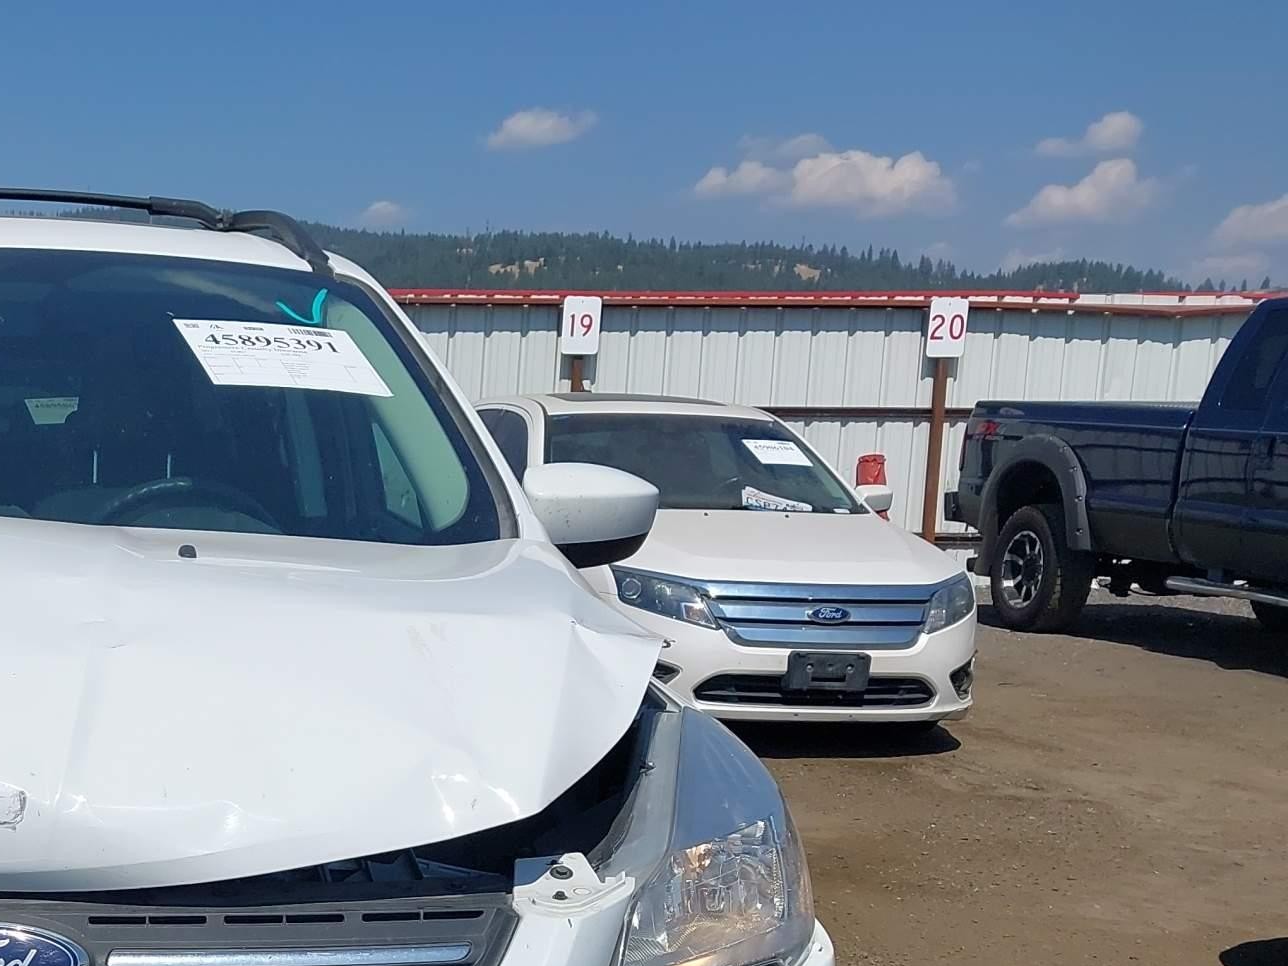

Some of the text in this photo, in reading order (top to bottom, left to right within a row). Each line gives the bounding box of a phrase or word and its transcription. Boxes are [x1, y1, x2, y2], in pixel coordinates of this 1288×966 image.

[570, 313, 593, 337] 19
[929, 314, 965, 341] 20
[205, 333, 340, 353] 45895391
[818, 607, 843, 619] Ford
